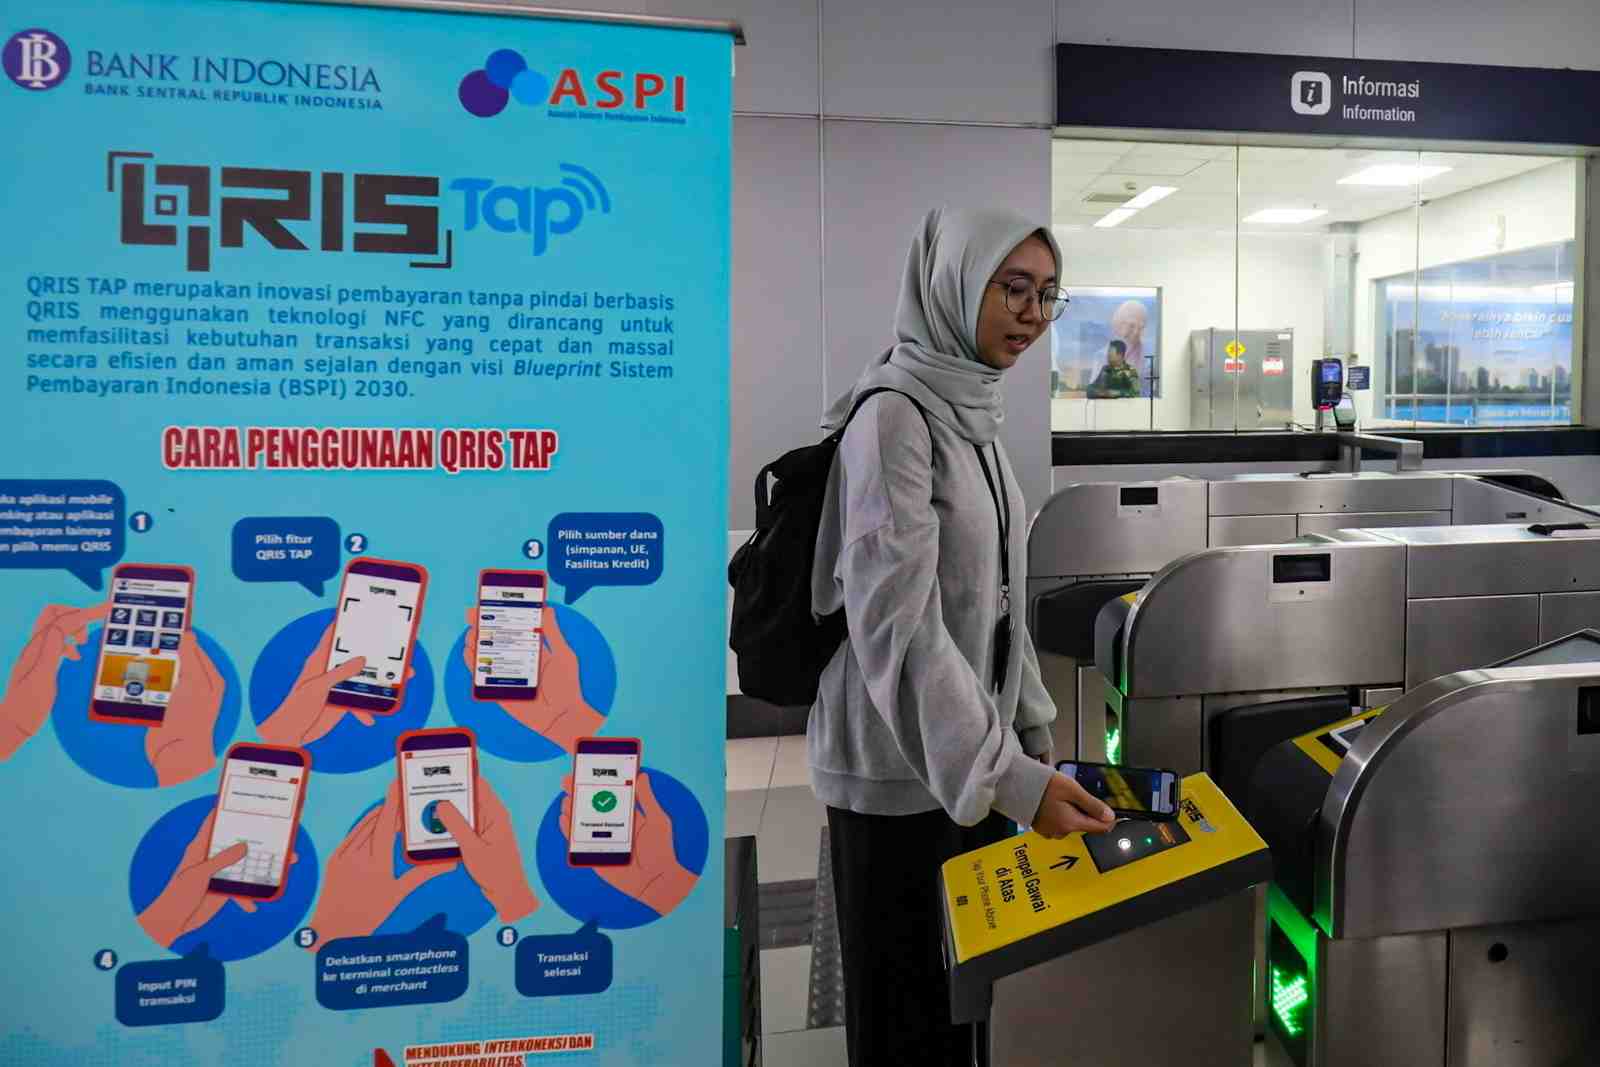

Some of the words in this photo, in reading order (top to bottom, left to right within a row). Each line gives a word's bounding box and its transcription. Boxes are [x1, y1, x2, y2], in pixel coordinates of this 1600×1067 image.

[87, 50, 180, 80] BANK
[191, 57, 382, 92] INDONESIA
[549, 68, 685, 112] ASPI
[1342, 76, 1420, 98] Informasi
[84, 83, 130, 97] BANK
[137, 86, 207, 101] SENTRAL
[212, 90, 288, 105] REPUBLIK
[294, 96, 384, 110] INDONESIA
[1342, 104, 1416, 122] Information
[121, 162, 439, 271] QRIS
[450, 177, 584, 256] Tap
[26, 276, 80, 295] QRIS
[88, 277, 127, 296] TAP
[133, 281, 251, 301] merupakan
[257, 282, 332, 302] inovasi
[338, 286, 462, 306] pembayaran
[468, 290, 524, 308] tanpa
[530, 291, 588, 309] pindai
[593, 292, 674, 311] berbasis
[26, 301, 80, 321] QRIS
[100, 304, 250, 326] menggunakan
[268, 307, 367, 330] teknologi
[385, 310, 425, 328] NFC
[442, 313, 490, 332] yang
[508, 313, 604, 335] dirancang
[620, 316, 674, 334] untuk
[26, 327, 170, 346] memfasilitasi
[186, 328, 298, 348] kebutuhan
[315, 331, 410, 350] transaksi
[425, 338, 473, 355] yang
[489, 337, 543, 356] cepat
[558, 337, 593, 354] dan
[608, 339, 674, 356] massal
[26, 353, 98, 370] secara
[108, 351, 177, 370] efisien
[187, 353, 226, 371] dan
[236, 357, 294, 372] aman
[304, 355, 378, 377] sejalan
[387, 357, 462, 378] dengan
[471, 359, 504, 376] visi
[513, 359, 602, 378] Blueprint
[609, 360, 674, 379] Sistem
[26, 375, 159, 398] Pembayaran
[166, 376, 271, 396] Indonesia
[278, 377, 347, 400] (BSPI)
[354, 380, 415, 397] 2030.
[163, 427, 241, 469] CARA
[246, 428, 434, 469] PENGGUNAAN
[440, 429, 504, 473] QRIS
[508, 430, 557, 469] TAP
[18, 494, 66, 506] aplikasi
[68, 494, 113, 504] mobile
[35, 511, 64, 521] atau
[65, 510, 114, 522] aplikasi
[135, 514, 148, 531] 1
[255, 534, 282, 544] Pilih
[286, 534, 313, 544] fitur
[558, 530, 583, 540] Pilih
[585, 530, 627, 540] sumber
[630, 530, 658, 540] dana
[12, 541, 39, 553] pilih
[41, 543, 79, 552] menu
[80, 541, 112, 553] QRIS
[350, 536, 363, 552] 2
[528, 542, 540, 557] 3
[565, 544, 628, 556] (simpanan,
[630, 545, 649, 556] UE,
[255, 549, 286, 560] QRIS
[291, 549, 313, 560] TAP
[565, 559, 609, 569] Fasilitas
[612, 559, 650, 570] Kredit)
[1014, 843, 1039, 879] Tempel
[995, 867, 1012, 879] di
[1000, 878, 1016, 903] Atas
[1025, 878, 1051, 913] Gawai
[300, 929, 313, 946] 5
[502, 928, 514, 945] 6
[100, 952, 113, 968] 4
[326, 954, 383, 967] Dekatkan
[385, 949, 457, 963] smartphone
[536, 952, 589, 963] Transaksi
[322, 972, 337, 982] ke
[340, 967, 391, 981] terminal
[394, 963, 460, 977] contactless
[543, 966, 582, 978] selesai
[138, 980, 172, 992] Input
[174, 978, 198, 988] PIN
[355, 983, 368, 994] di
[371, 980, 428, 993] merchant
[139, 993, 196, 1007] transaksi
[406, 1042, 481, 1060] MENDUKUNG
[484, 1037, 568, 1053] INTERKONEKSI
[569, 1035, 593, 1049] DAN
